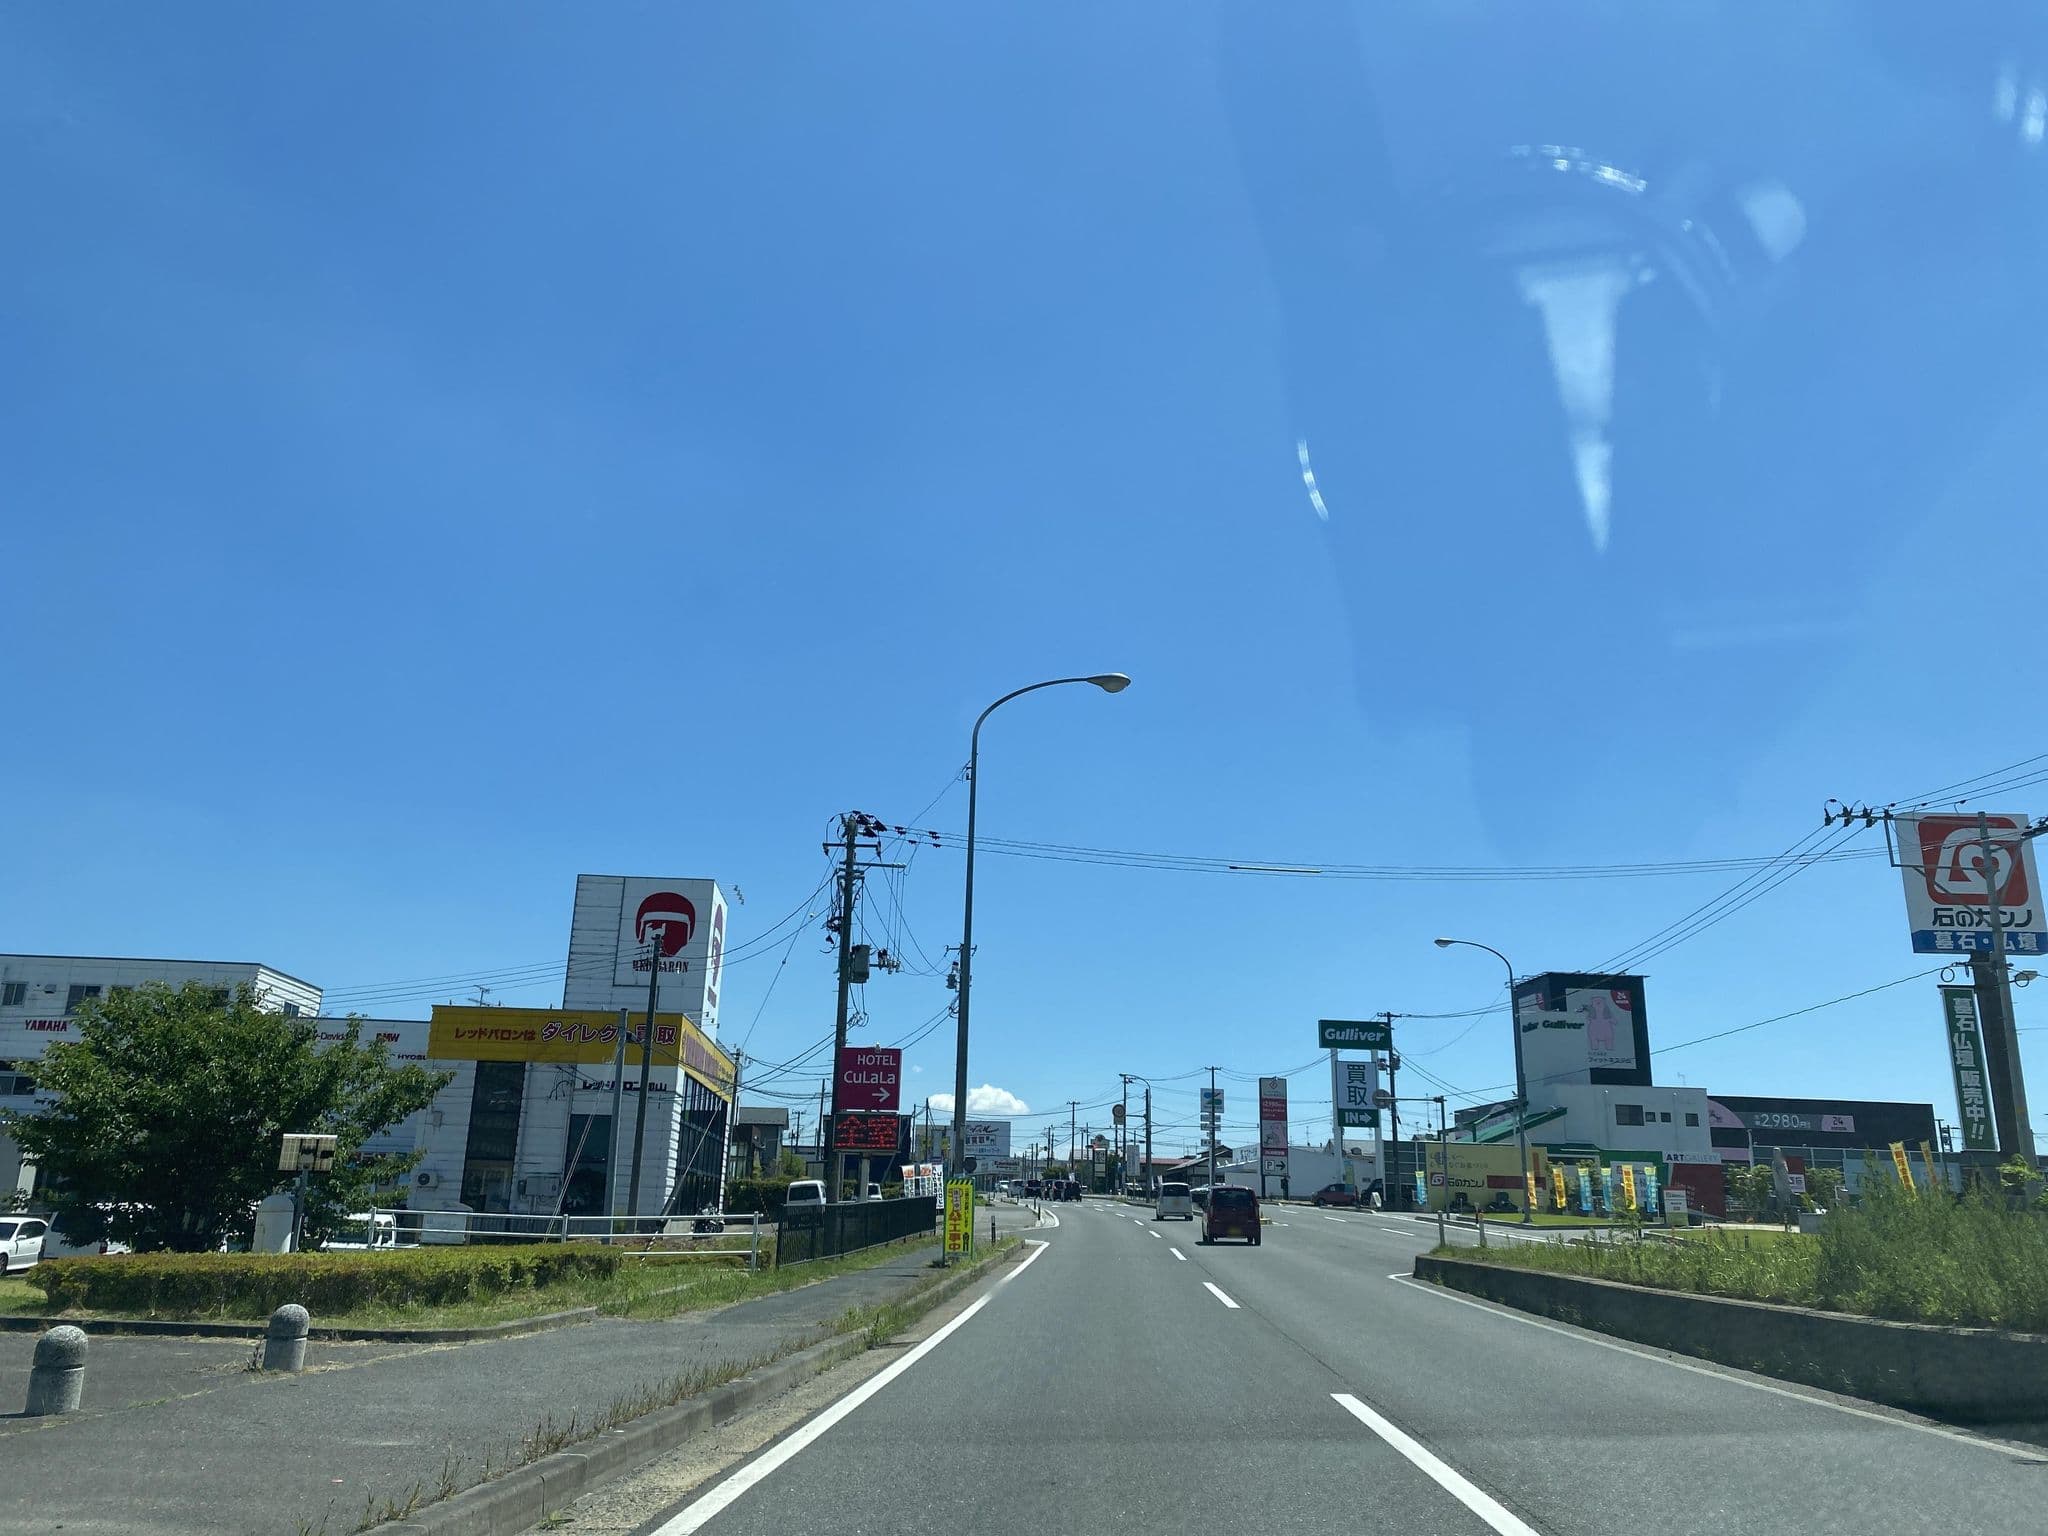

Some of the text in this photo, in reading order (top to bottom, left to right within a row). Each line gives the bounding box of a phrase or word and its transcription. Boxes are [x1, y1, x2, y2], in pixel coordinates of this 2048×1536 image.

[25, 1019, 68, 1032] YAMAHA
[455, 1022, 677, 1045] レッドバロンは ダイレク買取
[1324, 1027, 1385, 1042] Gulliver
[857, 1054, 897, 1066] HOTEL
[843, 1070, 896, 1085] CuLaLa
[1346, 1063, 1368, 1106] 買取
[1344, 1112, 1359, 1124] IN
